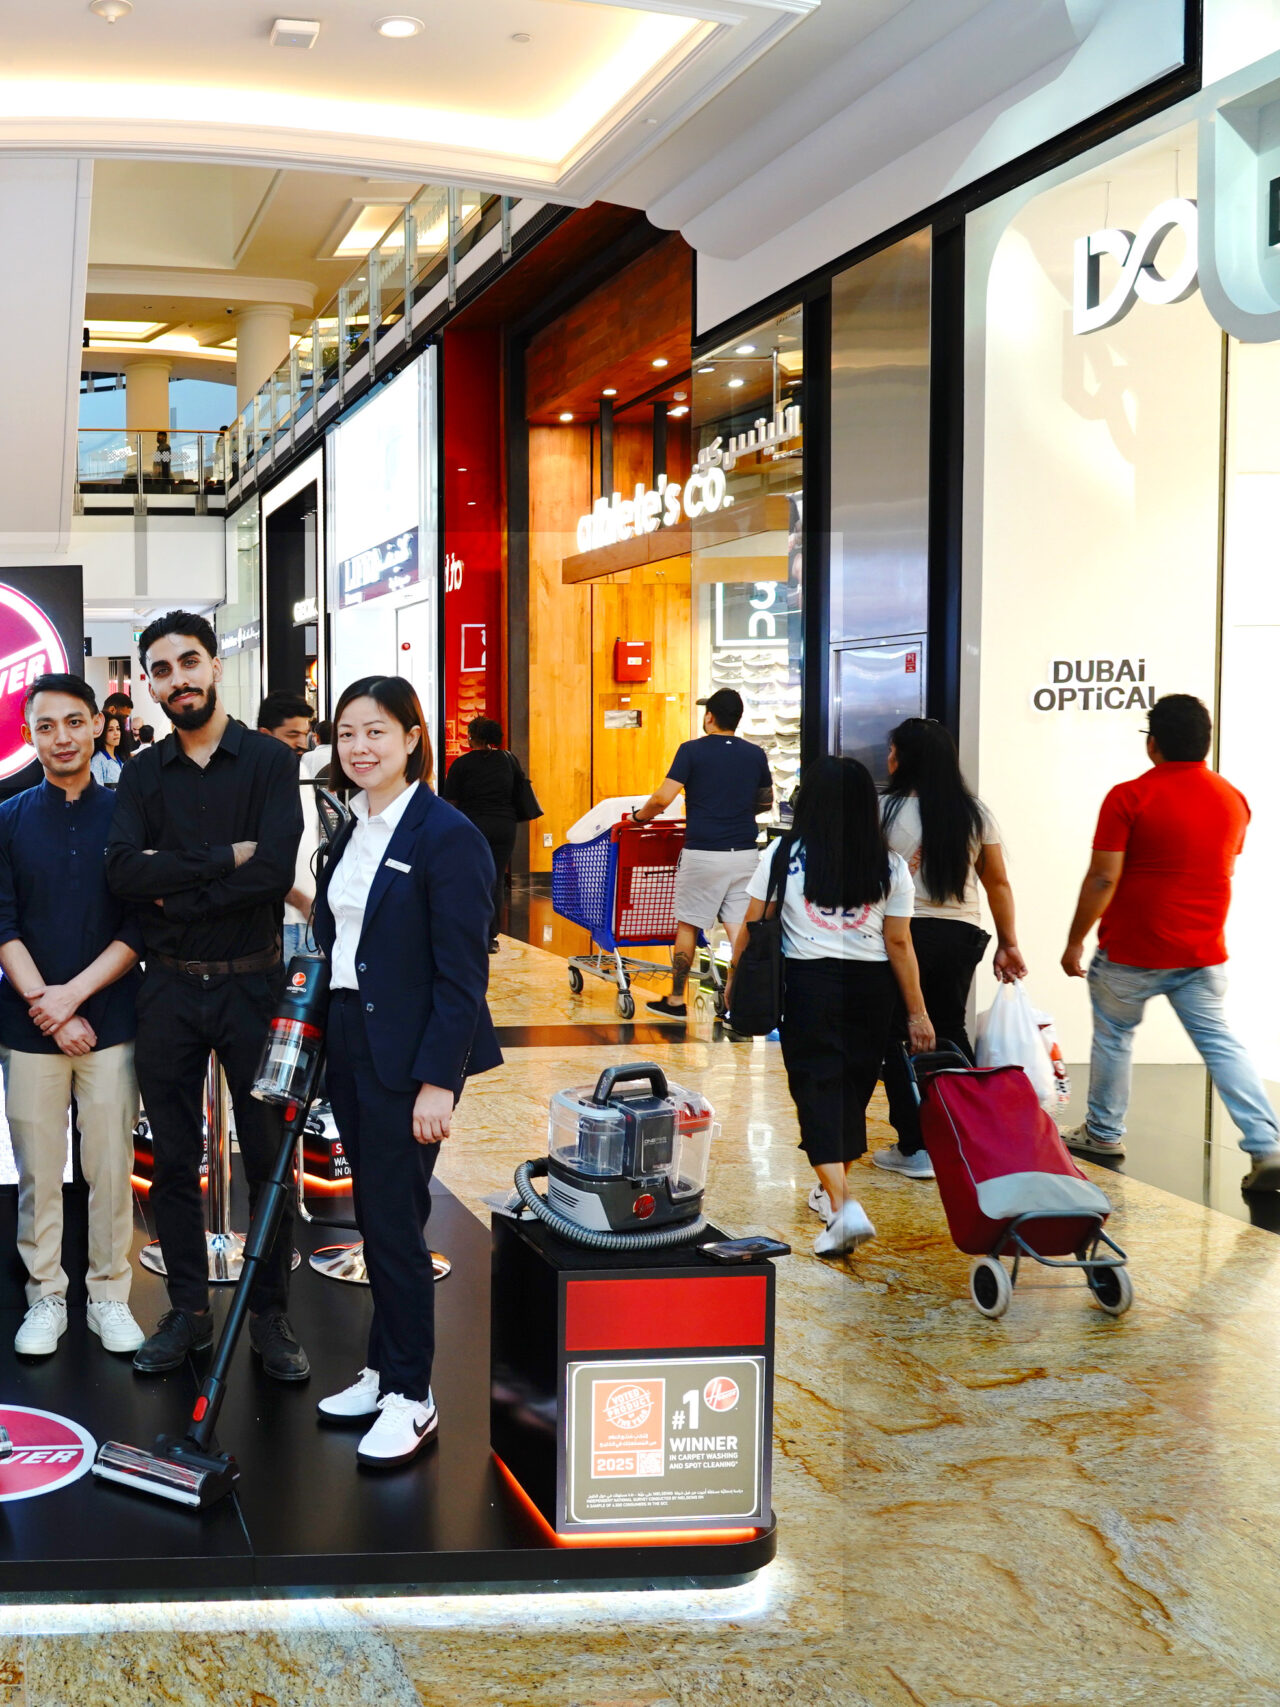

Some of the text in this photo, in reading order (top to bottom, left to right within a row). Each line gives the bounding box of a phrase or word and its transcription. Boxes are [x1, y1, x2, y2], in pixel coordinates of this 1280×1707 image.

[611, 1388, 640, 1405] VOTED
[671, 1389, 700, 1430] #1
[669, 1435, 738, 1452] WINNER
[596, 1457, 635, 1472] 2025
[706, 1452, 738, 1460] WASHING
